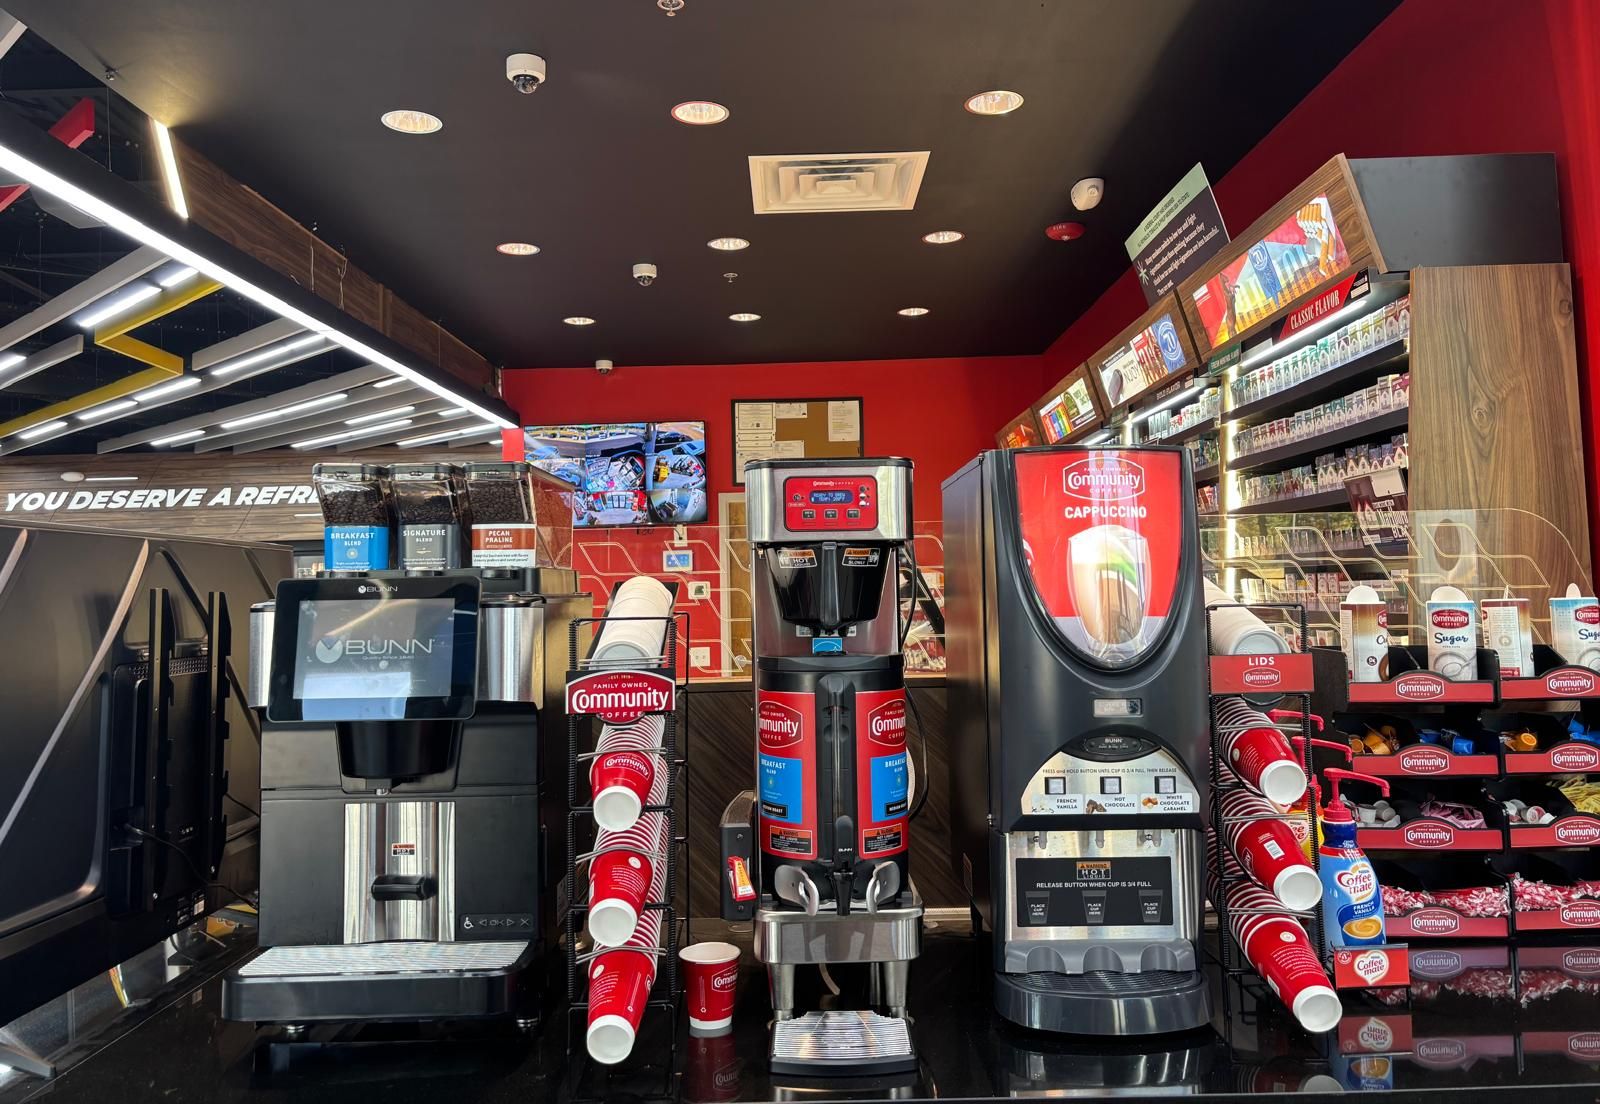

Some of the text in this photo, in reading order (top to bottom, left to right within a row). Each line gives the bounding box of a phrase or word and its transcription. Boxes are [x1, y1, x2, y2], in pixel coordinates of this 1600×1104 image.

[1290, 305, 1315, 330] CLASSIC
[1315, 289, 1340, 317] FLAVOR
[1068, 471, 1141, 490] Community
[5, 491, 70, 512] YOU
[67, 487, 209, 510] DESERVE
[207, 487, 232, 507] A
[1064, 506, 1147, 519] CAPPUCCINO
[402, 529, 446, 537] SIGNATURE
[1433, 614, 1468, 623] Community
[1434, 632, 1469, 645] Sugar
[345, 638, 433, 655] BUNN
[1248, 656, 1275, 666] LIDS
[1245, 672, 1279, 681] Community
[1398, 683, 1441, 693] Community
[1549, 679, 1591, 689] Community
[572, 687, 669, 713] Community
[600, 711, 644, 719] COFFEE
[1403, 757, 1446, 768] Community
[1553, 753, 1596, 764] Community
[1407, 830, 1450, 841] Community
[1337, 871, 1372, 887] Coffee
[1349, 882, 1373, 895] mate
[1353, 901, 1375, 911] FRENCH
[1354, 906, 1375, 915] VANILLA
[1413, 917, 1456, 928] Community
[1357, 958, 1383, 971] Coffee
[1364, 965, 1385, 976] mate
